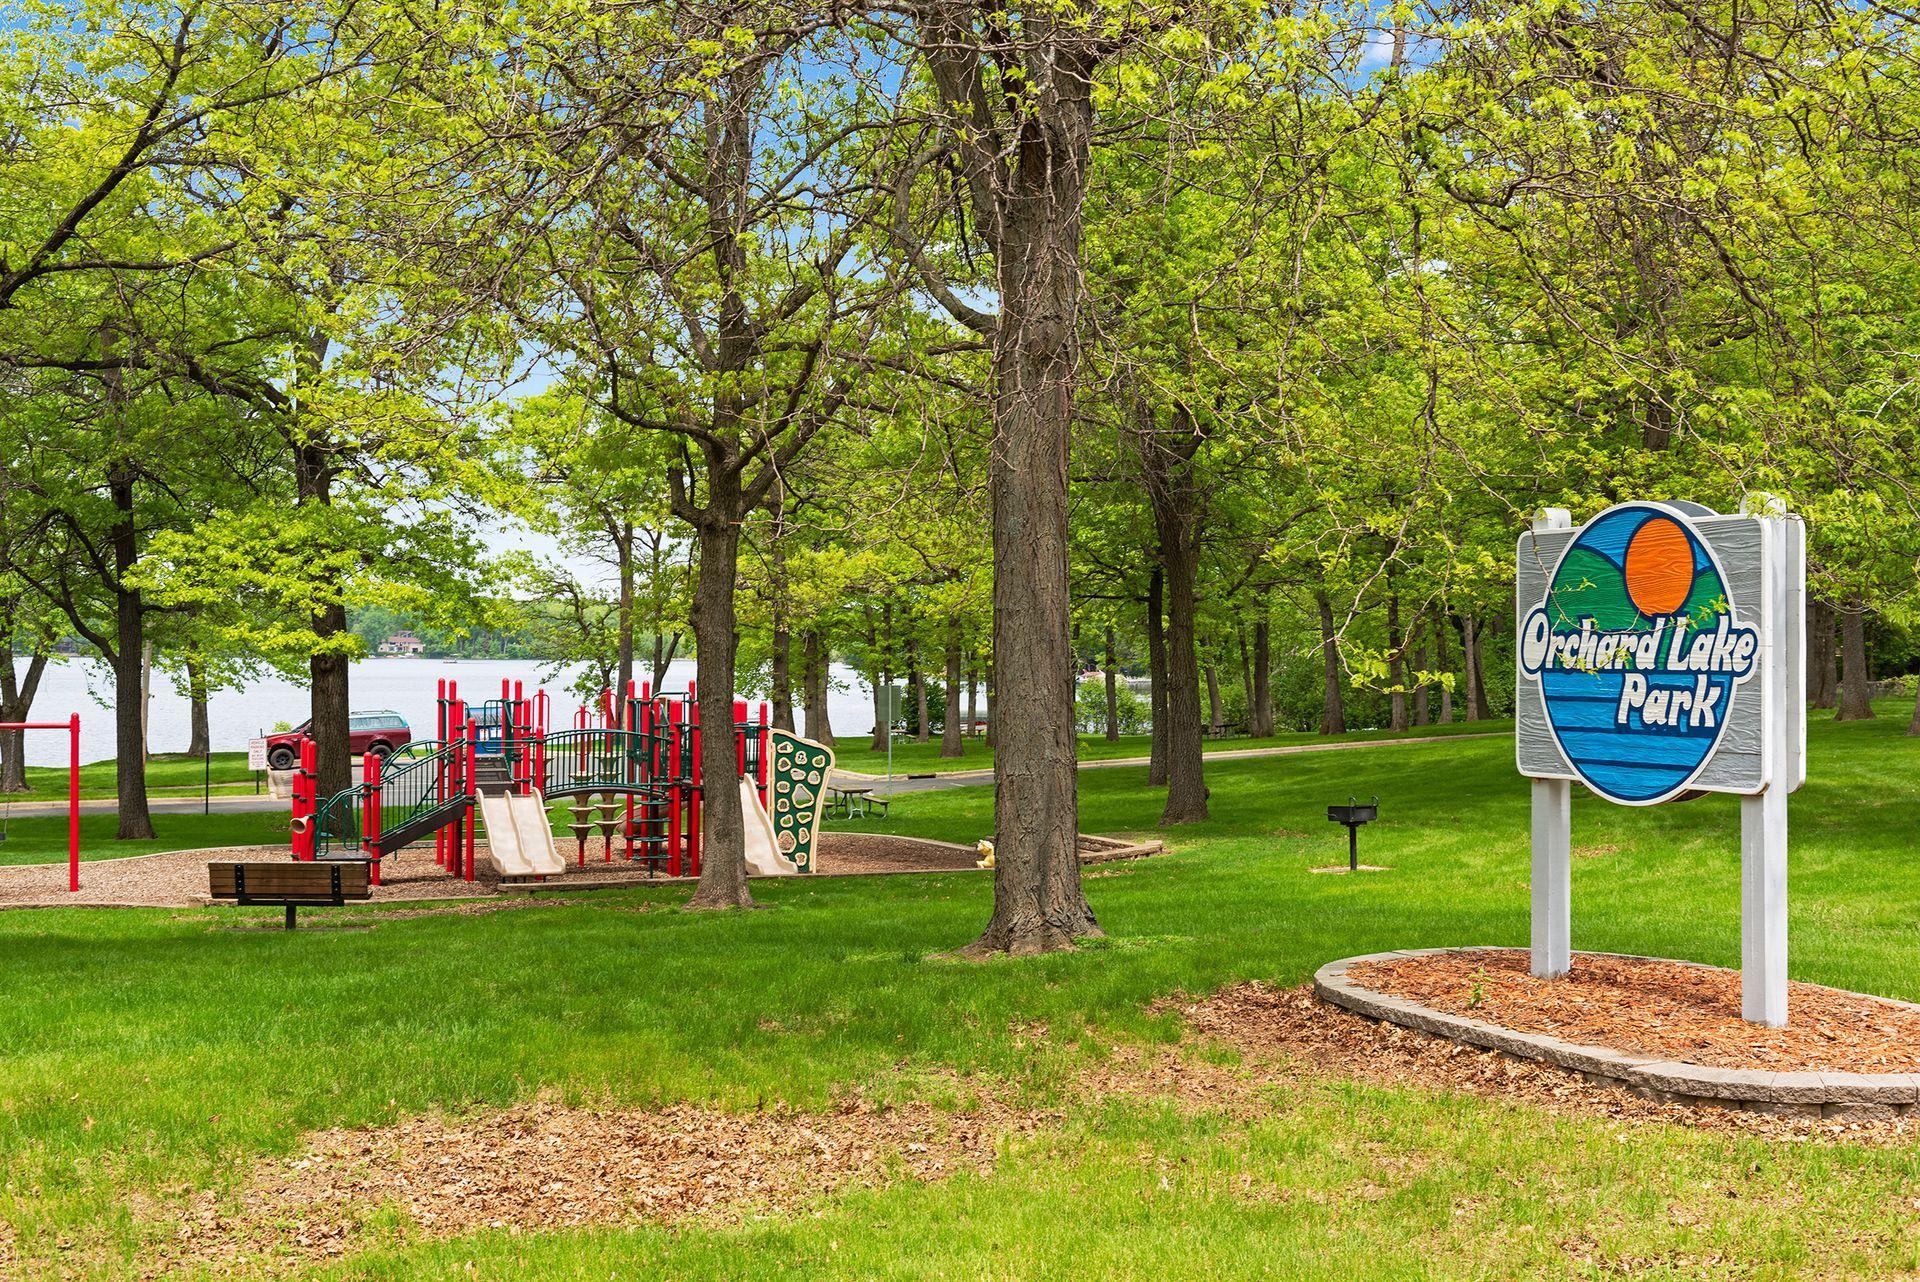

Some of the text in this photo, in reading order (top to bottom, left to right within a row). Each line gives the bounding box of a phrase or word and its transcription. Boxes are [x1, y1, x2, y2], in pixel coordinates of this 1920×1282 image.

[1523, 612, 1756, 672] Orchard Lake
[1617, 673, 1720, 727] Park
